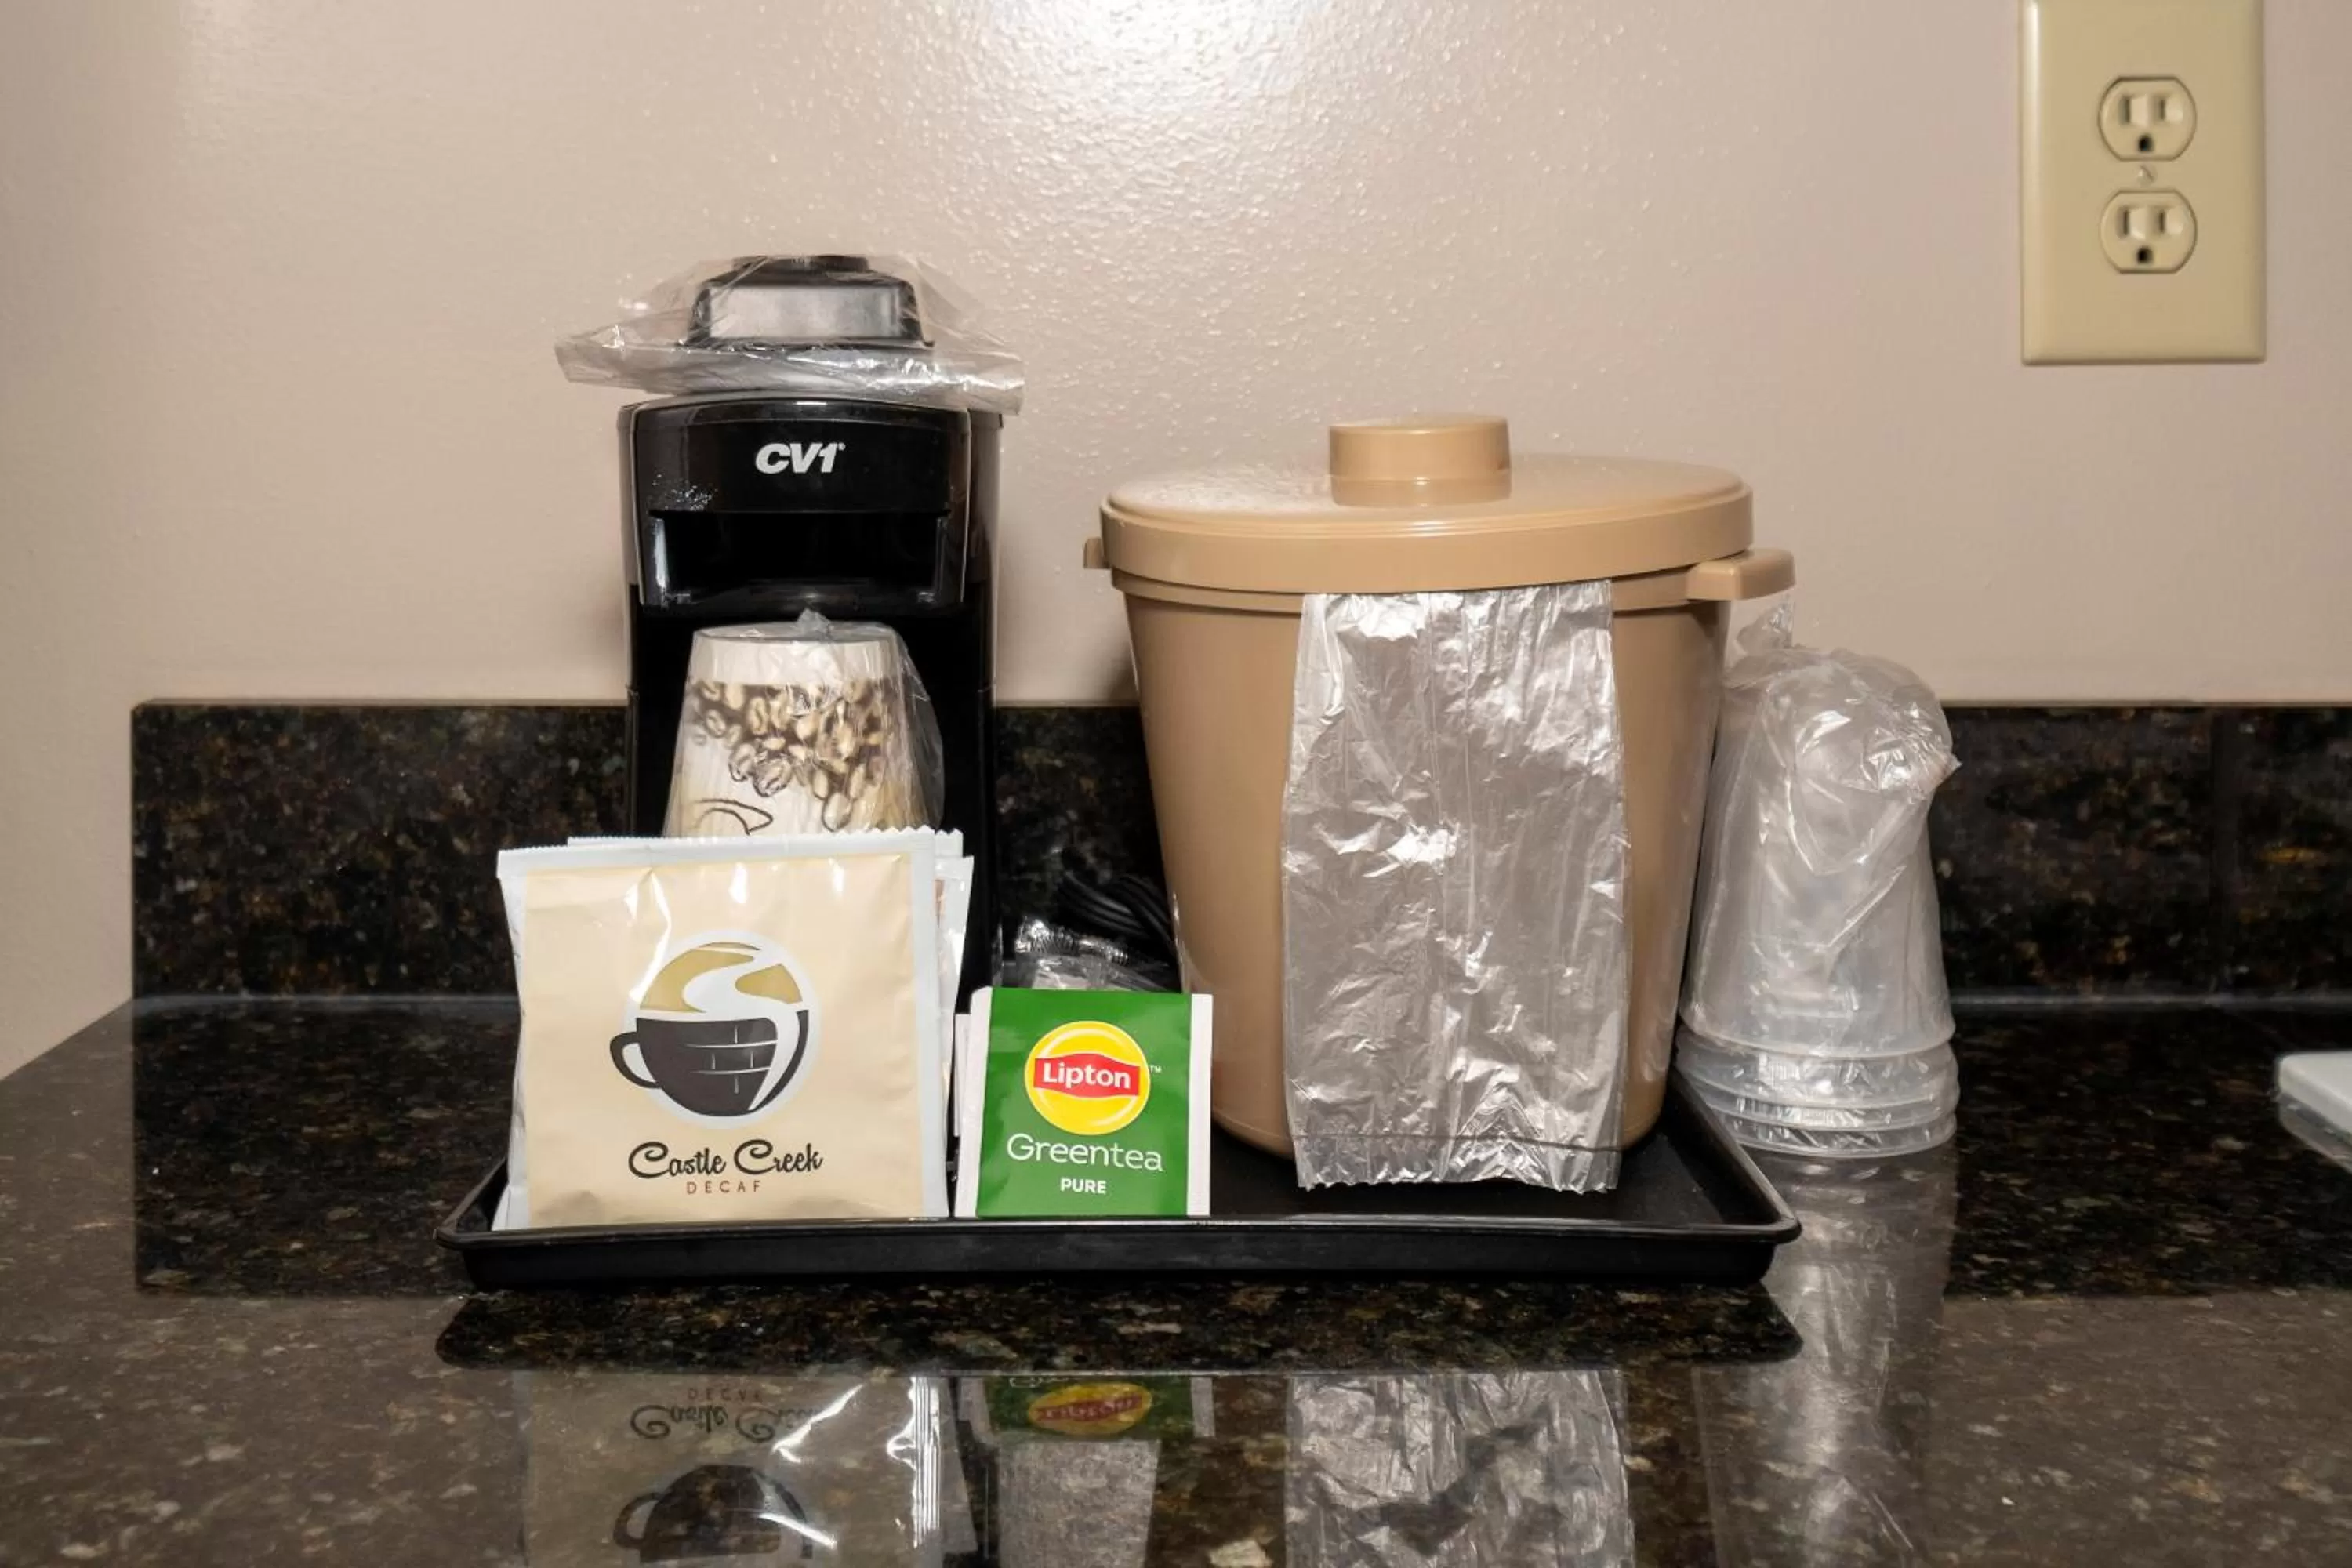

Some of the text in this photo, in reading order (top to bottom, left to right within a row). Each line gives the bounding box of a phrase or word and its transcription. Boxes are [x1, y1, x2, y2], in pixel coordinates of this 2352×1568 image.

[755, 442, 837, 474] CV1
[1042, 1062, 1131, 1089] Lipton
[628, 1139, 823, 1179] Castle Creek
[687, 1180, 761, 1194] DECAF
[1060, 1178, 1107, 1194] PURE
